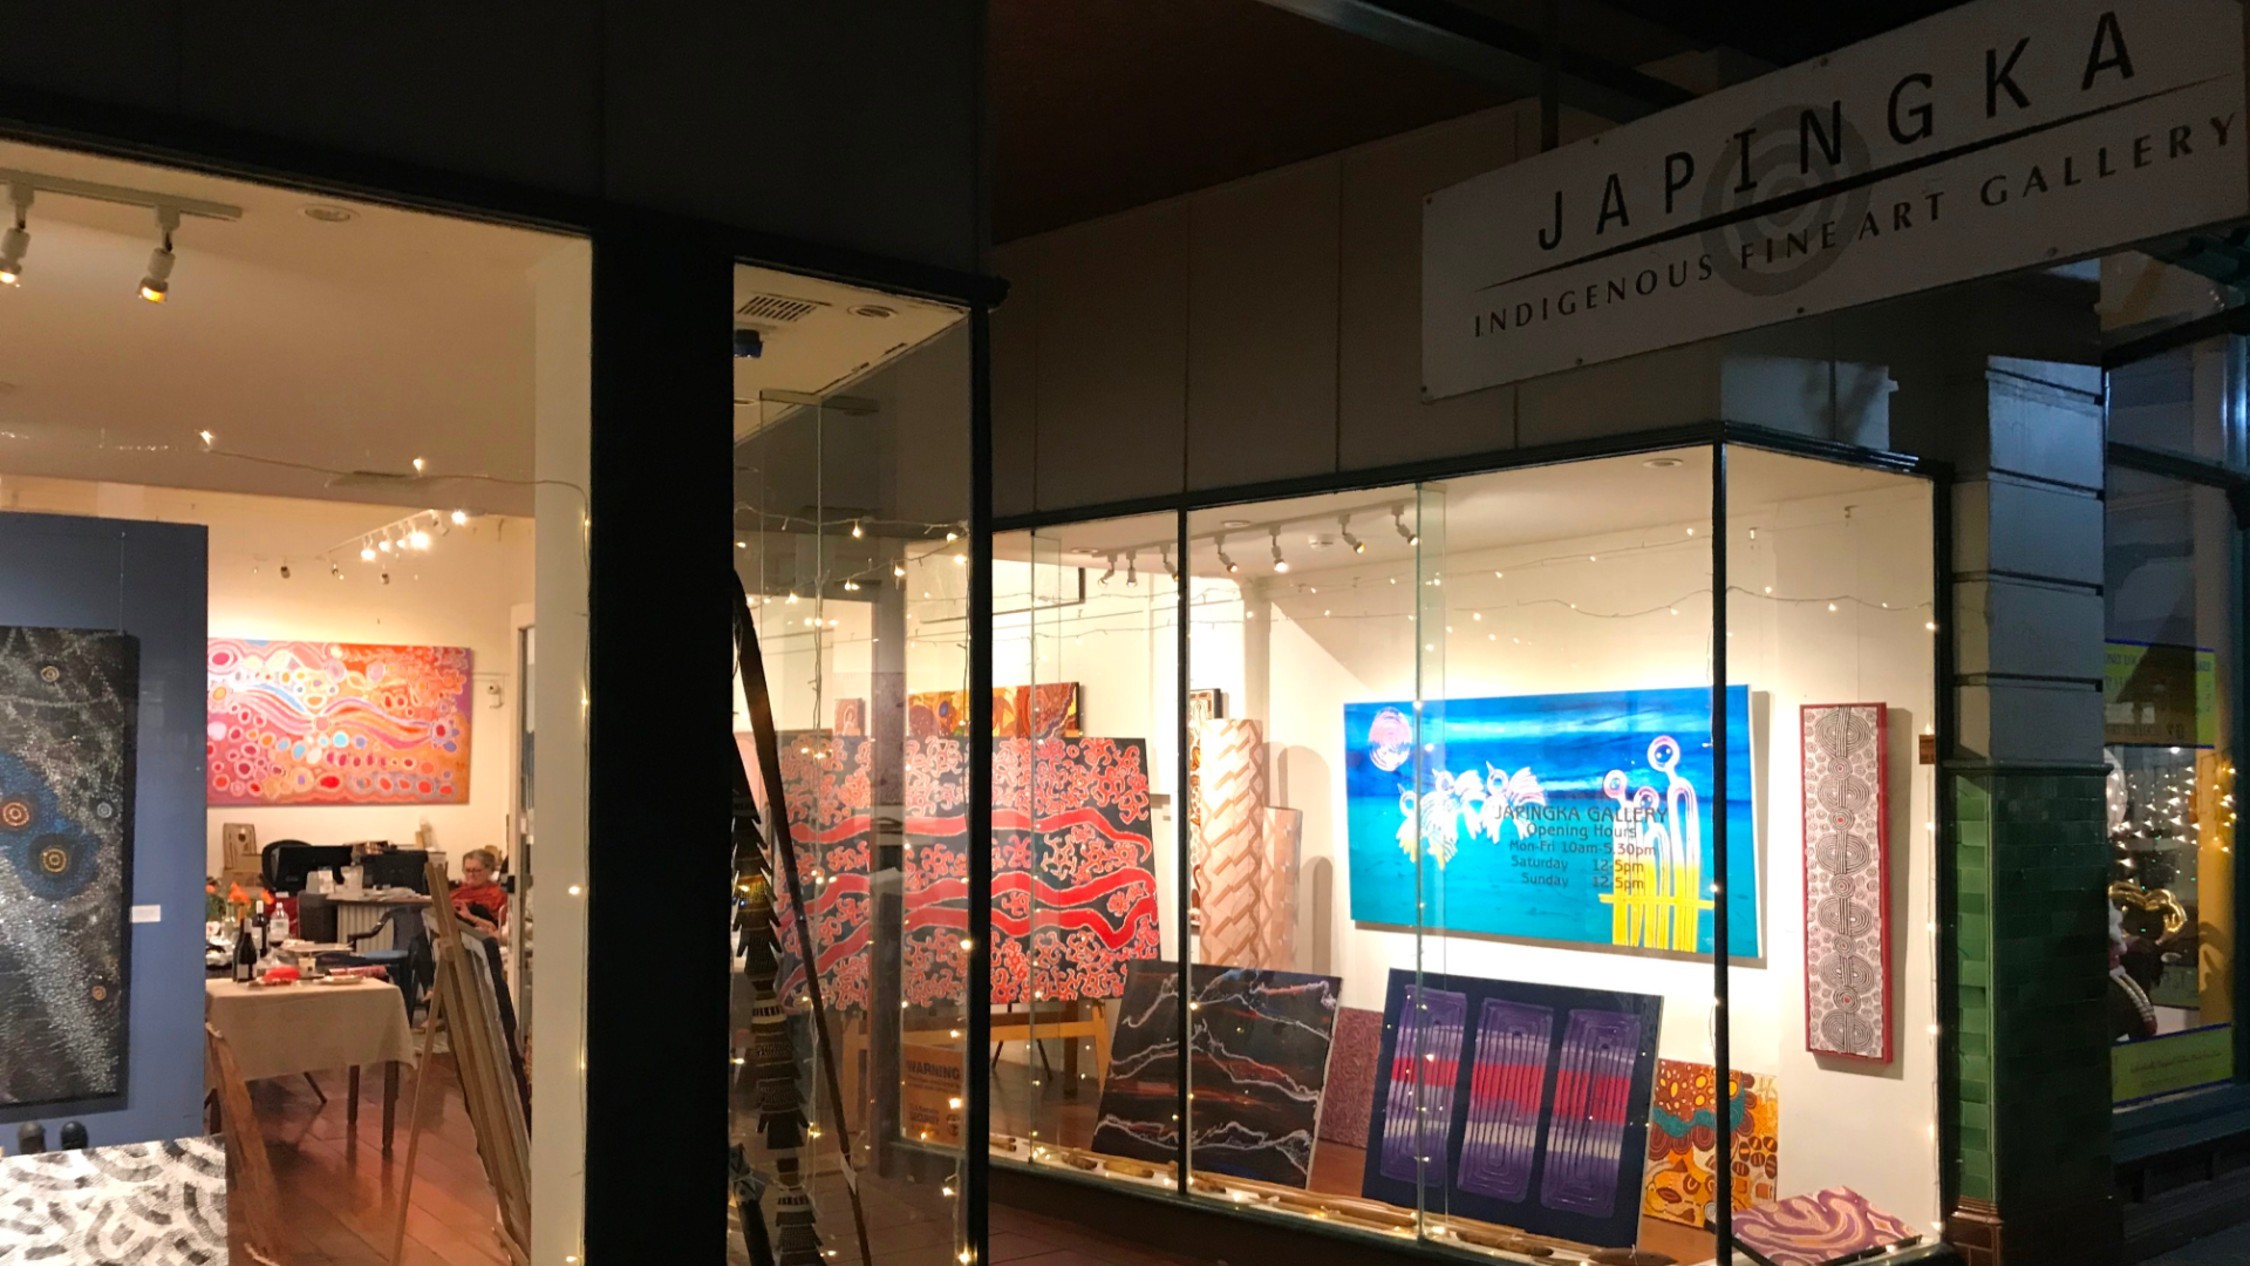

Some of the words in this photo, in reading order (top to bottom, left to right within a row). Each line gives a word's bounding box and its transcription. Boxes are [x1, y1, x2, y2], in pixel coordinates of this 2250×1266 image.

[1537, 10, 2136, 252] JAPINGKA
[1473, 253, 1714, 338] INDIGENOUS
[1740, 221, 1838, 270] FINE
[1857, 191, 1947, 241] ART
[1979, 112, 2236, 206] GALLERY
[1494, 804, 1580, 821] JAPINGKA
[1587, 805, 1668, 822] GALLERY
[1526, 822, 1588, 839] Opening
[1594, 823, 1637, 838] Hours
[1509, 839, 1555, 853] Mon-Fri
[1511, 855, 1569, 871] Saturday
[1592, 858, 1644, 874] 12-5pm
[1521, 872, 1569, 887] Sunday
[1592, 875, 1644, 890] 12-5pm
[906, 1060, 960, 1080] WARNING
